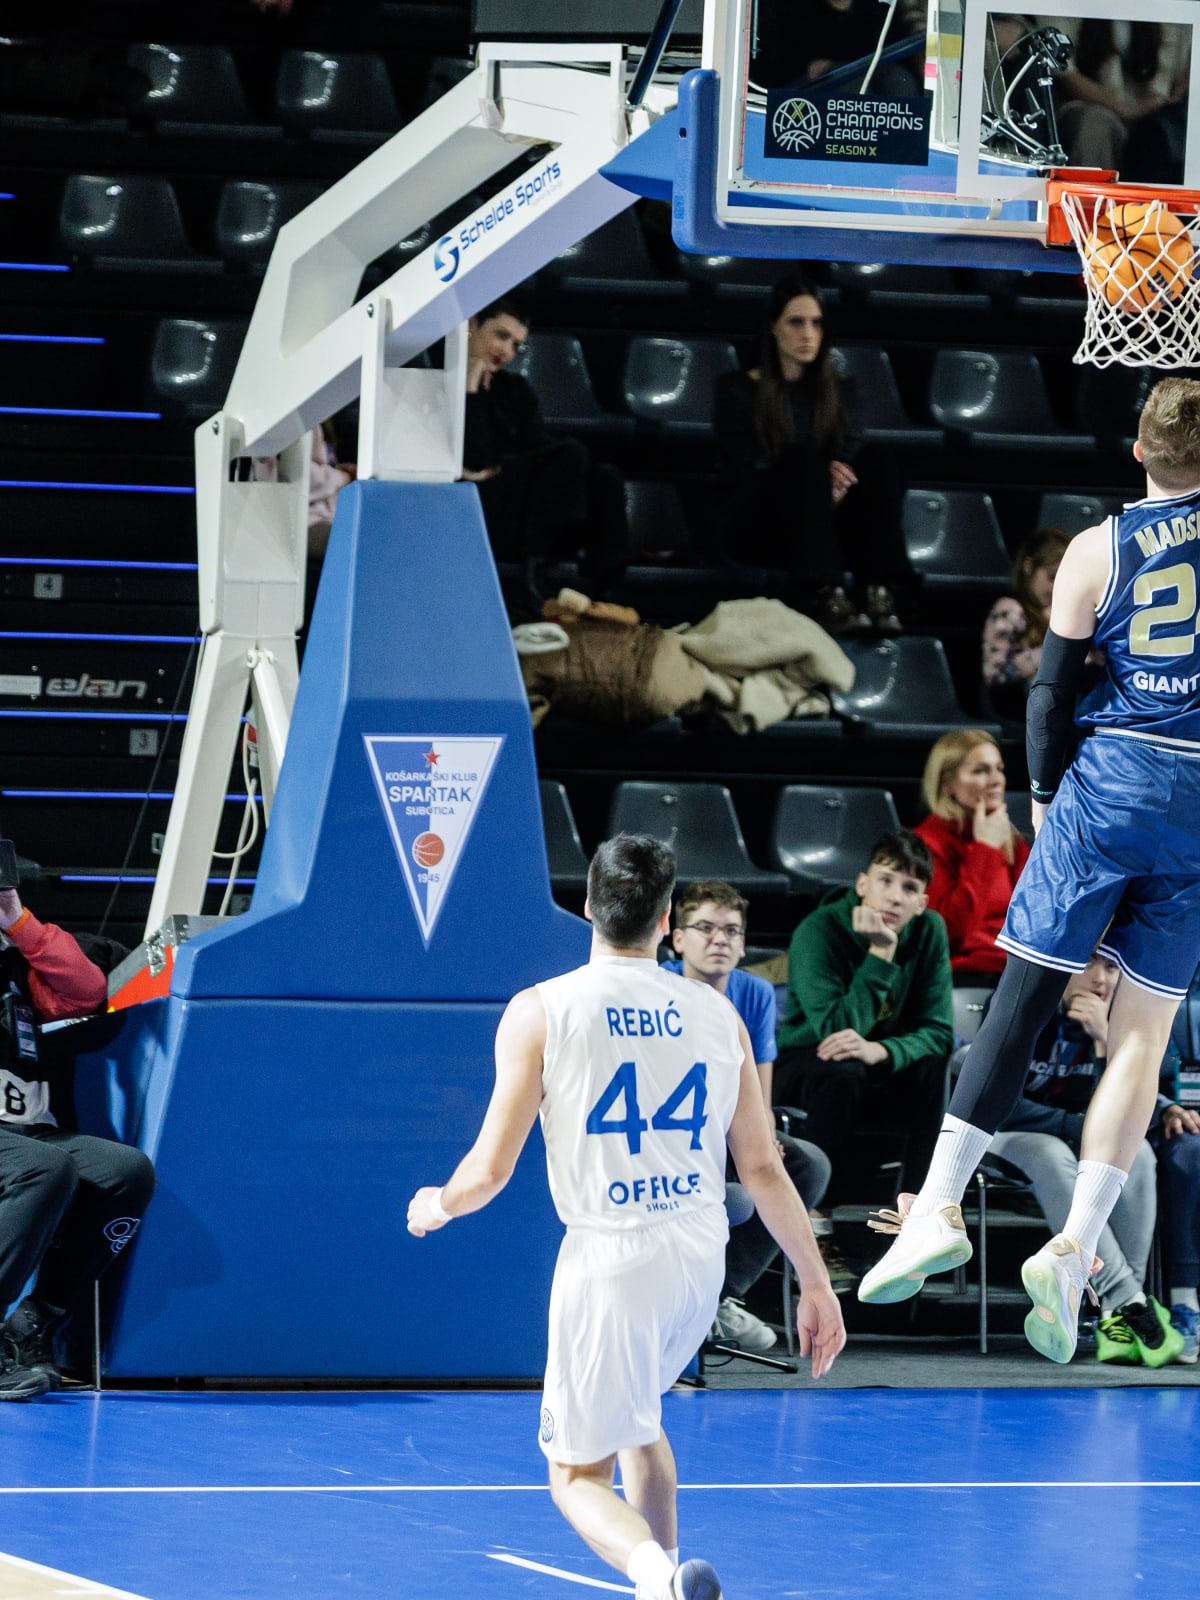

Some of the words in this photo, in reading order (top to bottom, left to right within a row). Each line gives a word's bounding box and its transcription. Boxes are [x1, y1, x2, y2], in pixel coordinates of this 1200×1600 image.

[827, 99, 913, 115] BASKETBALL
[826, 113, 924, 131] CHAMPIONS
[825, 128, 878, 141] LEAGUE
[825, 144, 866, 155] SEASON
[868, 146, 877, 157] X
[460, 198, 514, 250] Schelde
[515, 161, 561, 206] Sports
[46, 673, 147, 698] elan
[385, 770, 449, 781] KOŠARKAŠKI
[451, 772, 478, 781] KLUB
[389, 786, 472, 802] SPARTAK
[405, 806, 455, 816] SUBOTICA
[417, 873, 440, 883] 1945
[606, 1000, 683, 1038] REBIĆ
[586, 1061, 709, 1156] 44
[607, 1173, 701, 1205] OFFICE
